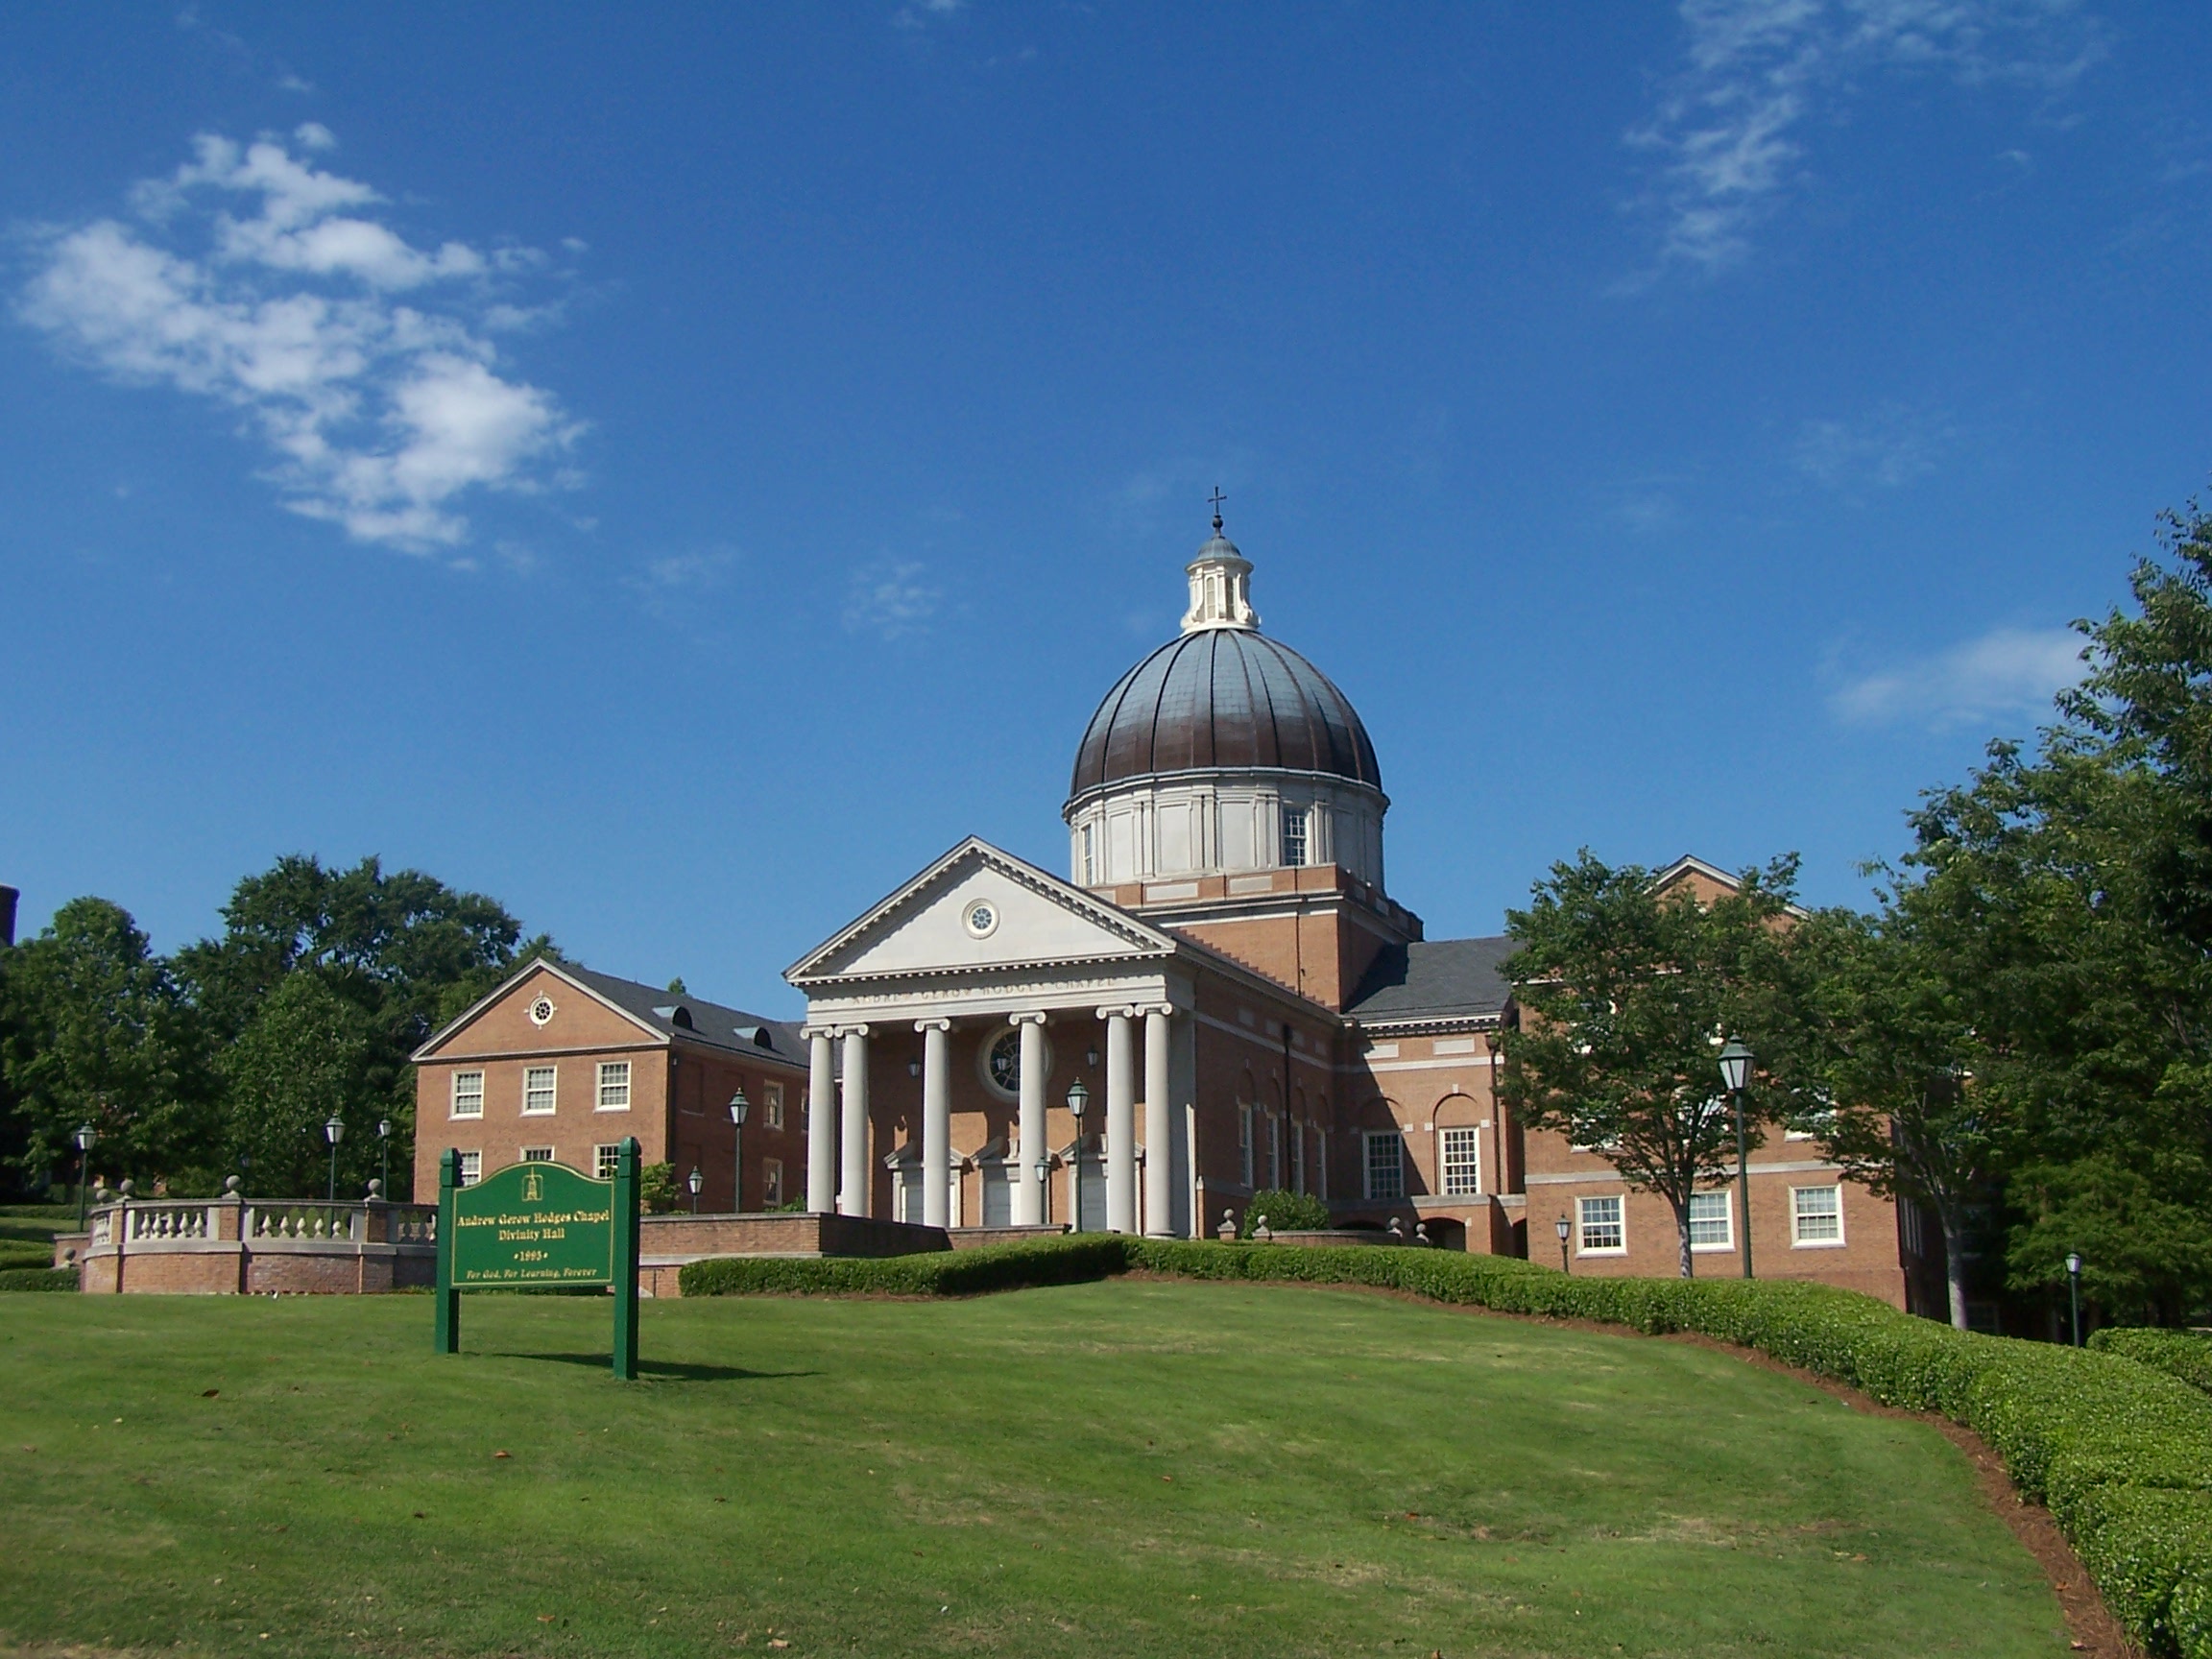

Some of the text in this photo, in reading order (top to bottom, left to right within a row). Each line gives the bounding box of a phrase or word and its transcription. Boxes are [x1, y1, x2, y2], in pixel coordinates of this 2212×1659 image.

[457, 1209, 610, 1227] Andrew Gerow Hodges Chapel
[498, 1228, 565, 1241] Divinity Hall
[467, 1269, 481, 1279] For
[504, 1268, 518, 1278] For
[563, 1266, 597, 1277] Forever
